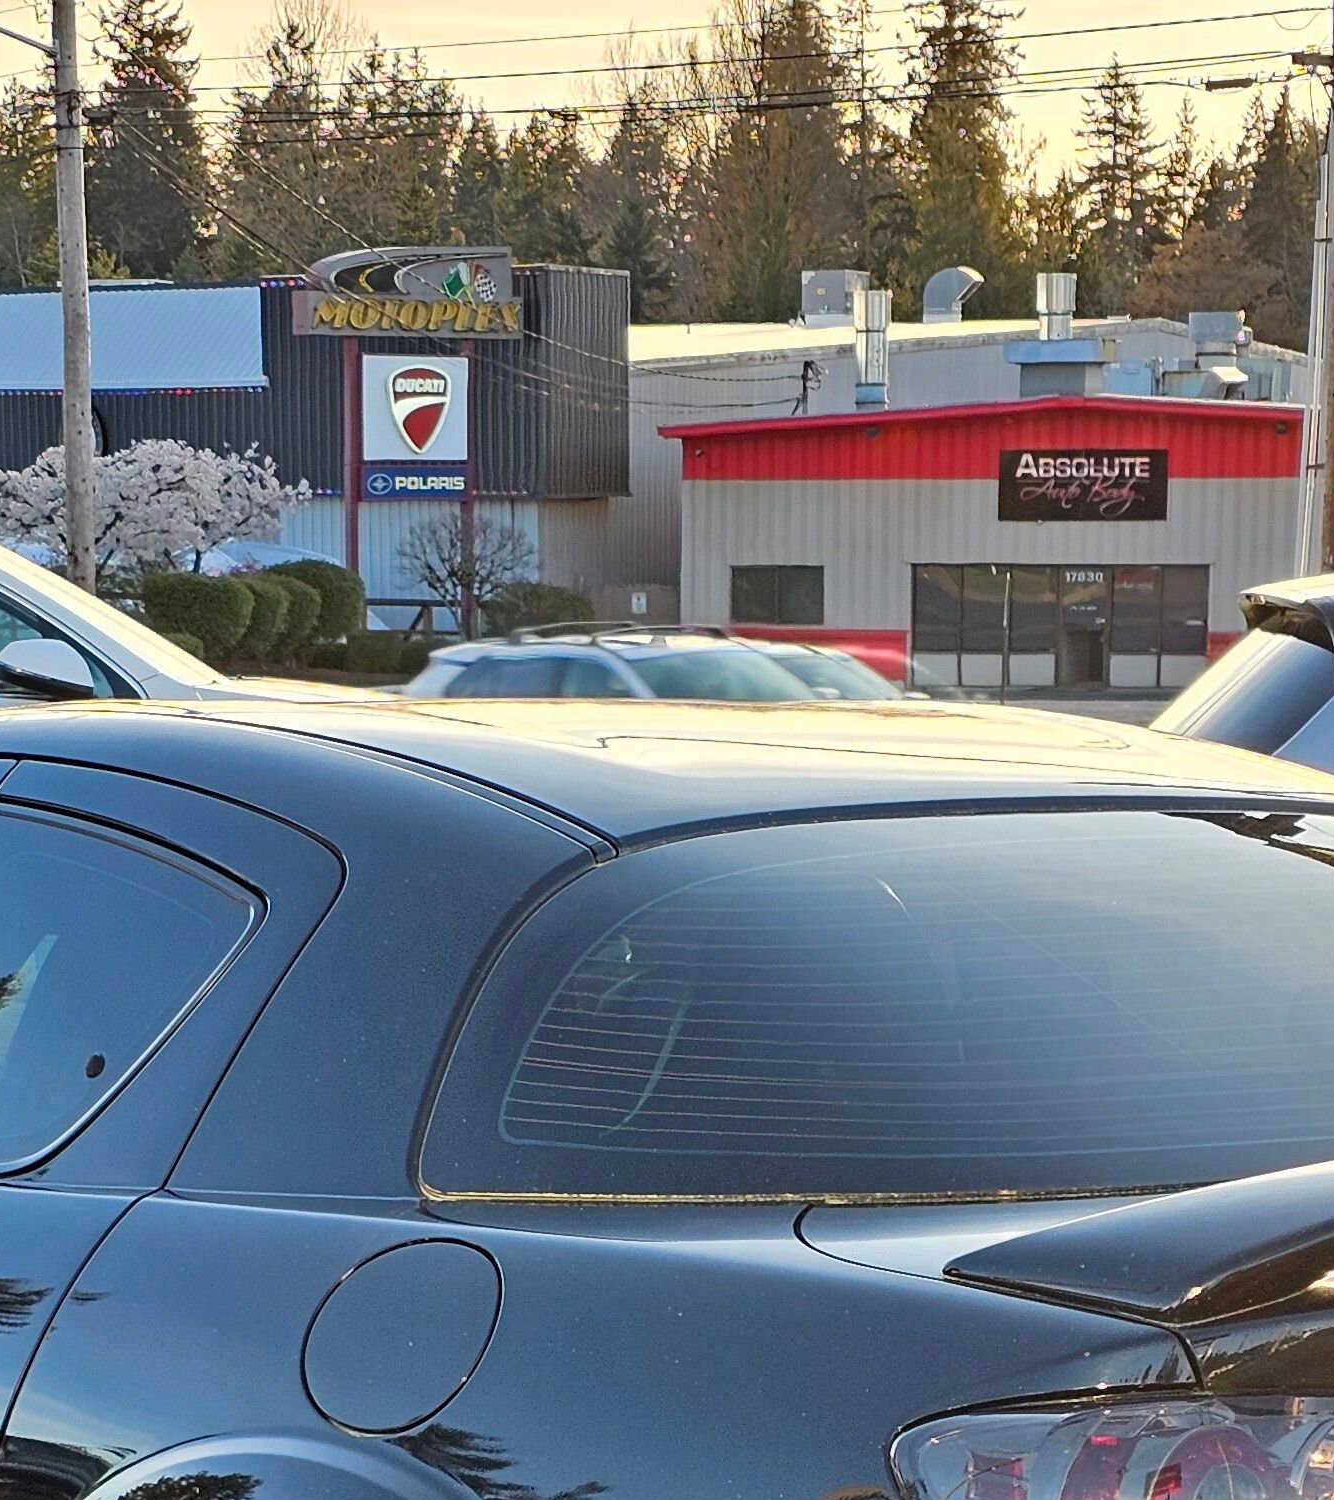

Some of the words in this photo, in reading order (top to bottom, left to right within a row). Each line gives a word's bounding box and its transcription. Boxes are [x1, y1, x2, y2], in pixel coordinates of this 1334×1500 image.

[312, 298, 523, 332] MOTOPLEX
[394, 378, 445, 393] DUCATI
[1016, 453, 1151, 478] ABSOLUTE
[395, 476, 465, 490] POLARIS
[1020, 478, 1083, 509] Auto
